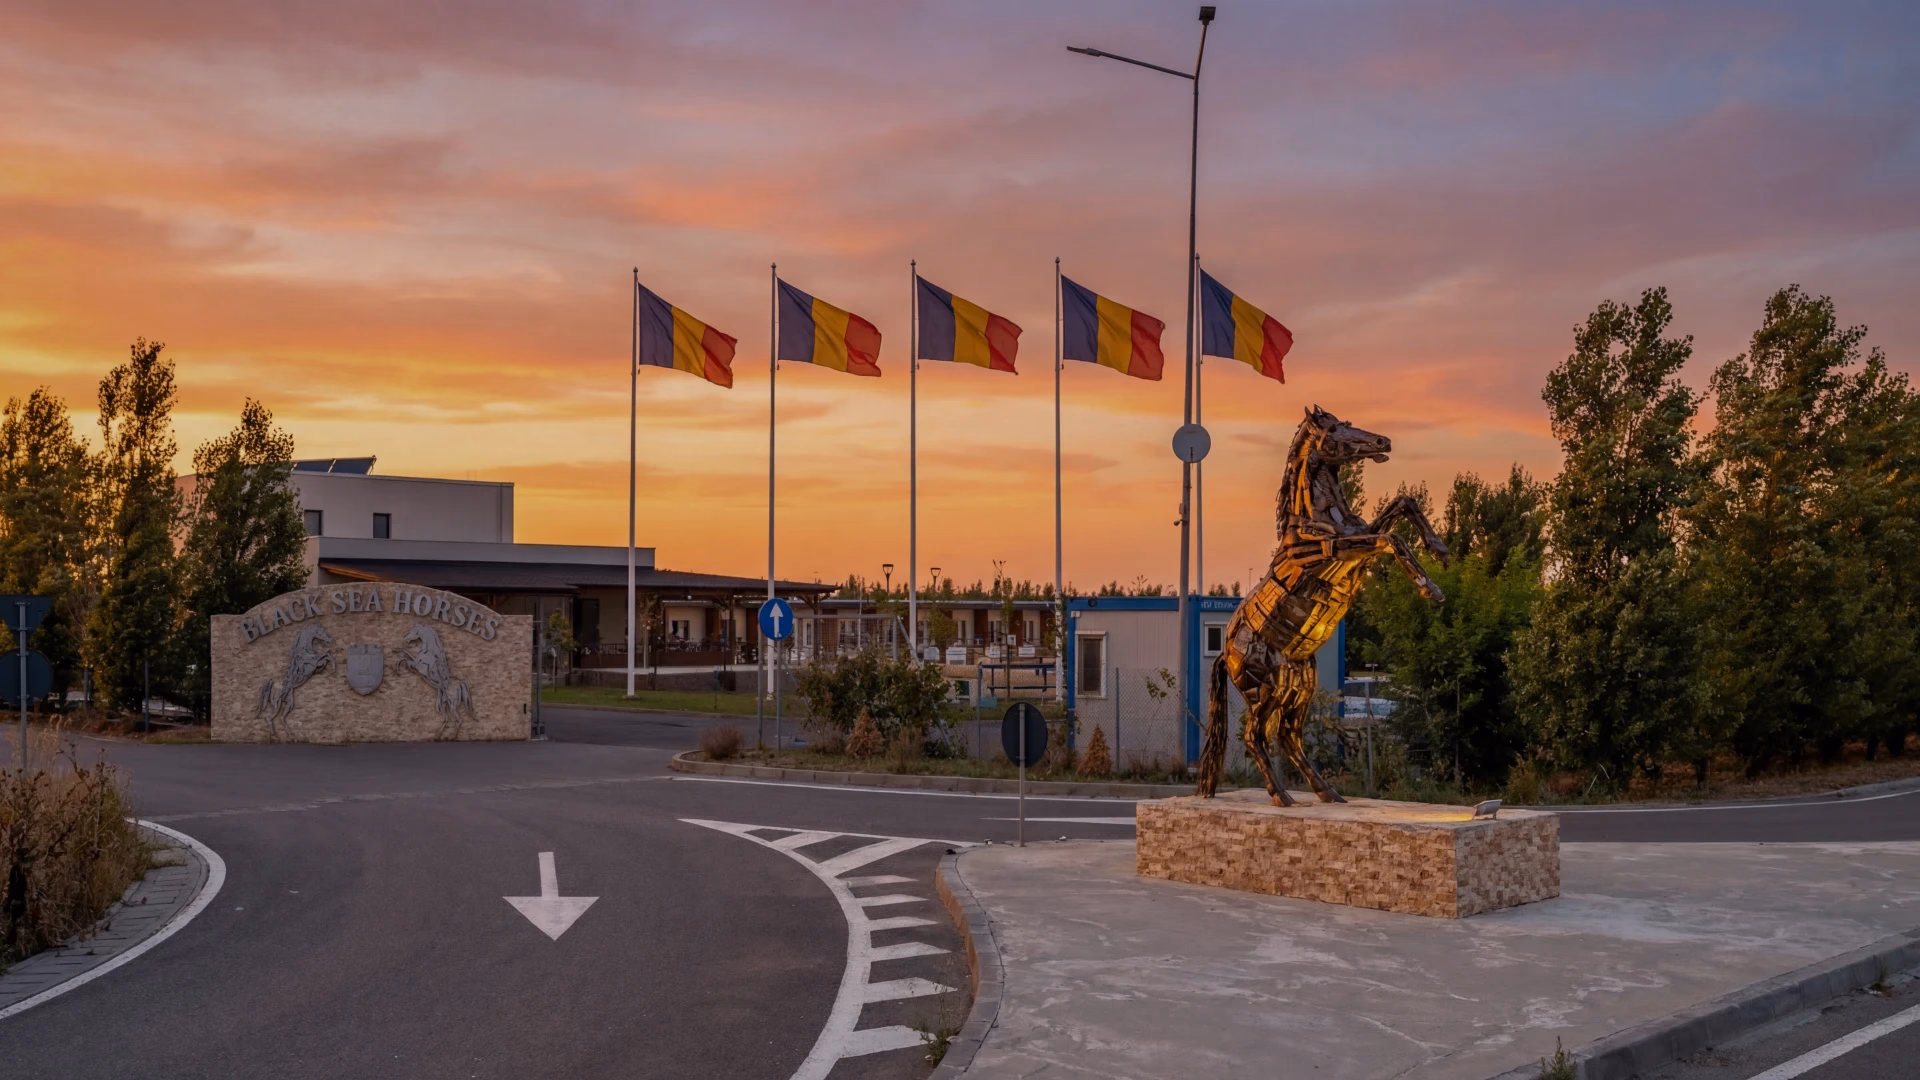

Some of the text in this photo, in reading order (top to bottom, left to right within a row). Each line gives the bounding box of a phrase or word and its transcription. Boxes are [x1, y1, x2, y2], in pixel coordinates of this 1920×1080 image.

[240, 589, 499, 643] BLACK SEA HORSES
